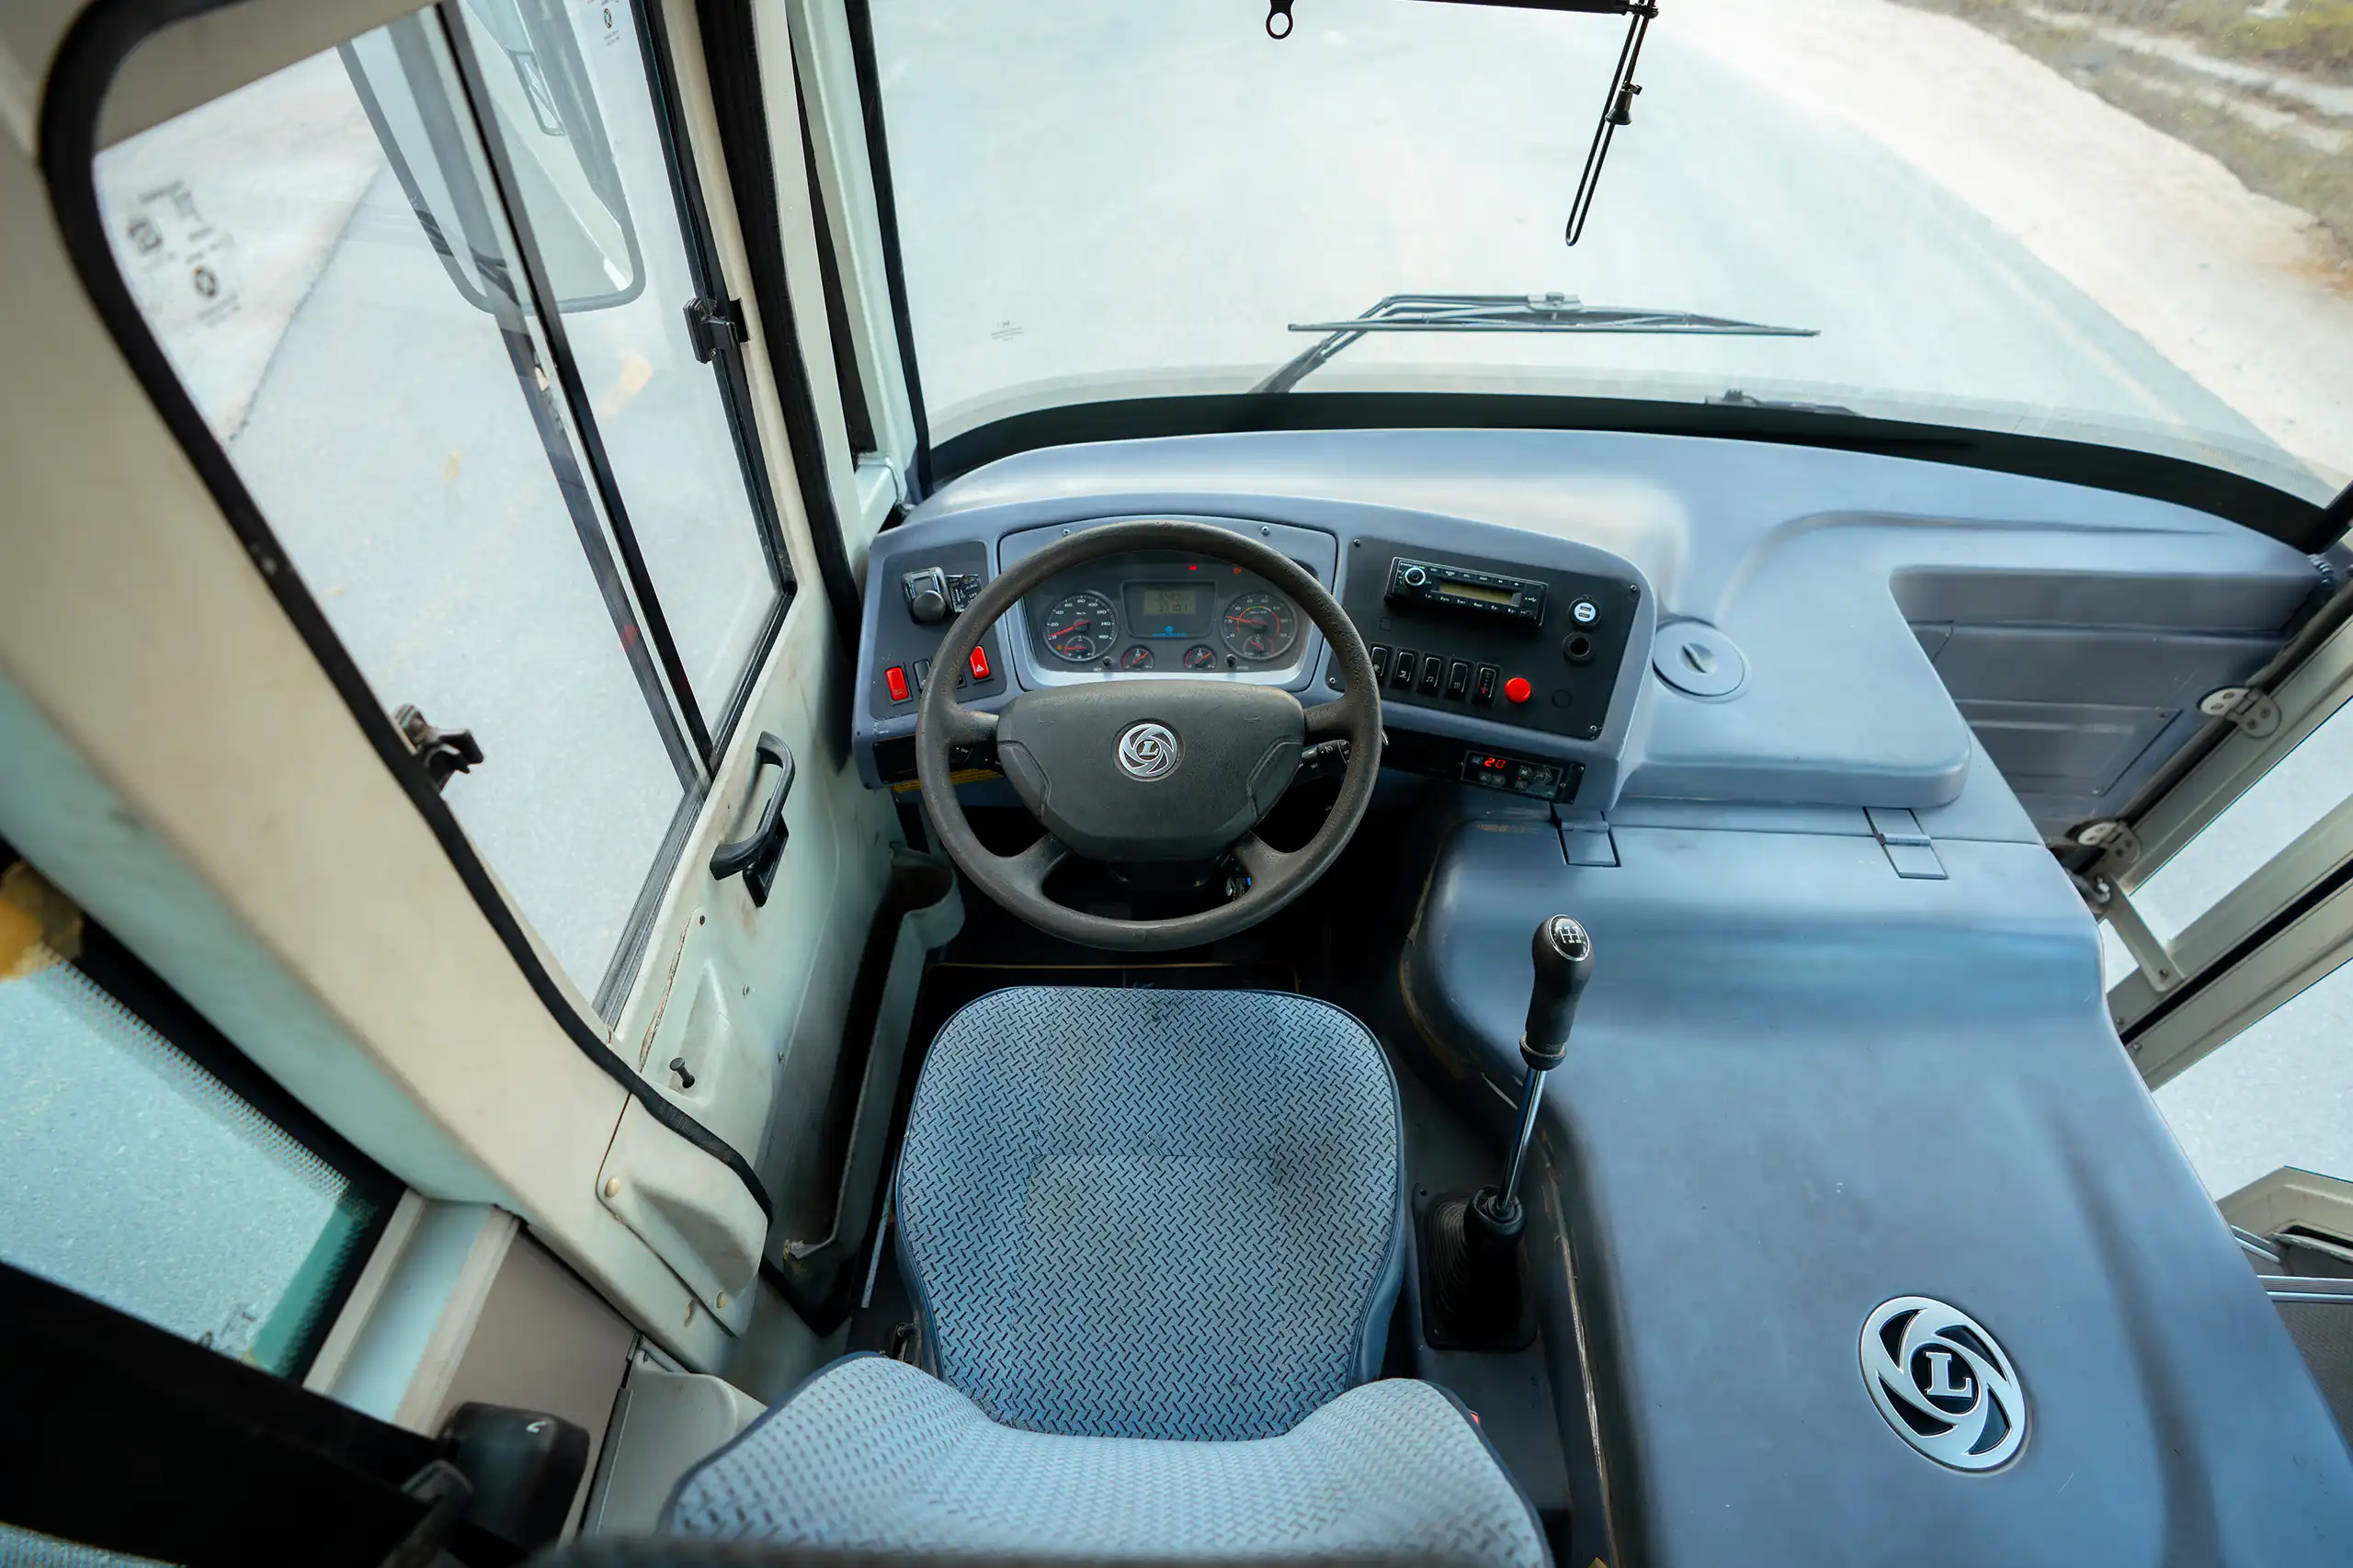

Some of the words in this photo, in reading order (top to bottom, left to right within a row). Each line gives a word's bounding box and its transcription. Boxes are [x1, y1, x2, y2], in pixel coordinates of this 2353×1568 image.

[1140, 740, 1159, 756] L
[1484, 756, 1506, 769] 20
[1925, 1351, 1973, 1399] L
